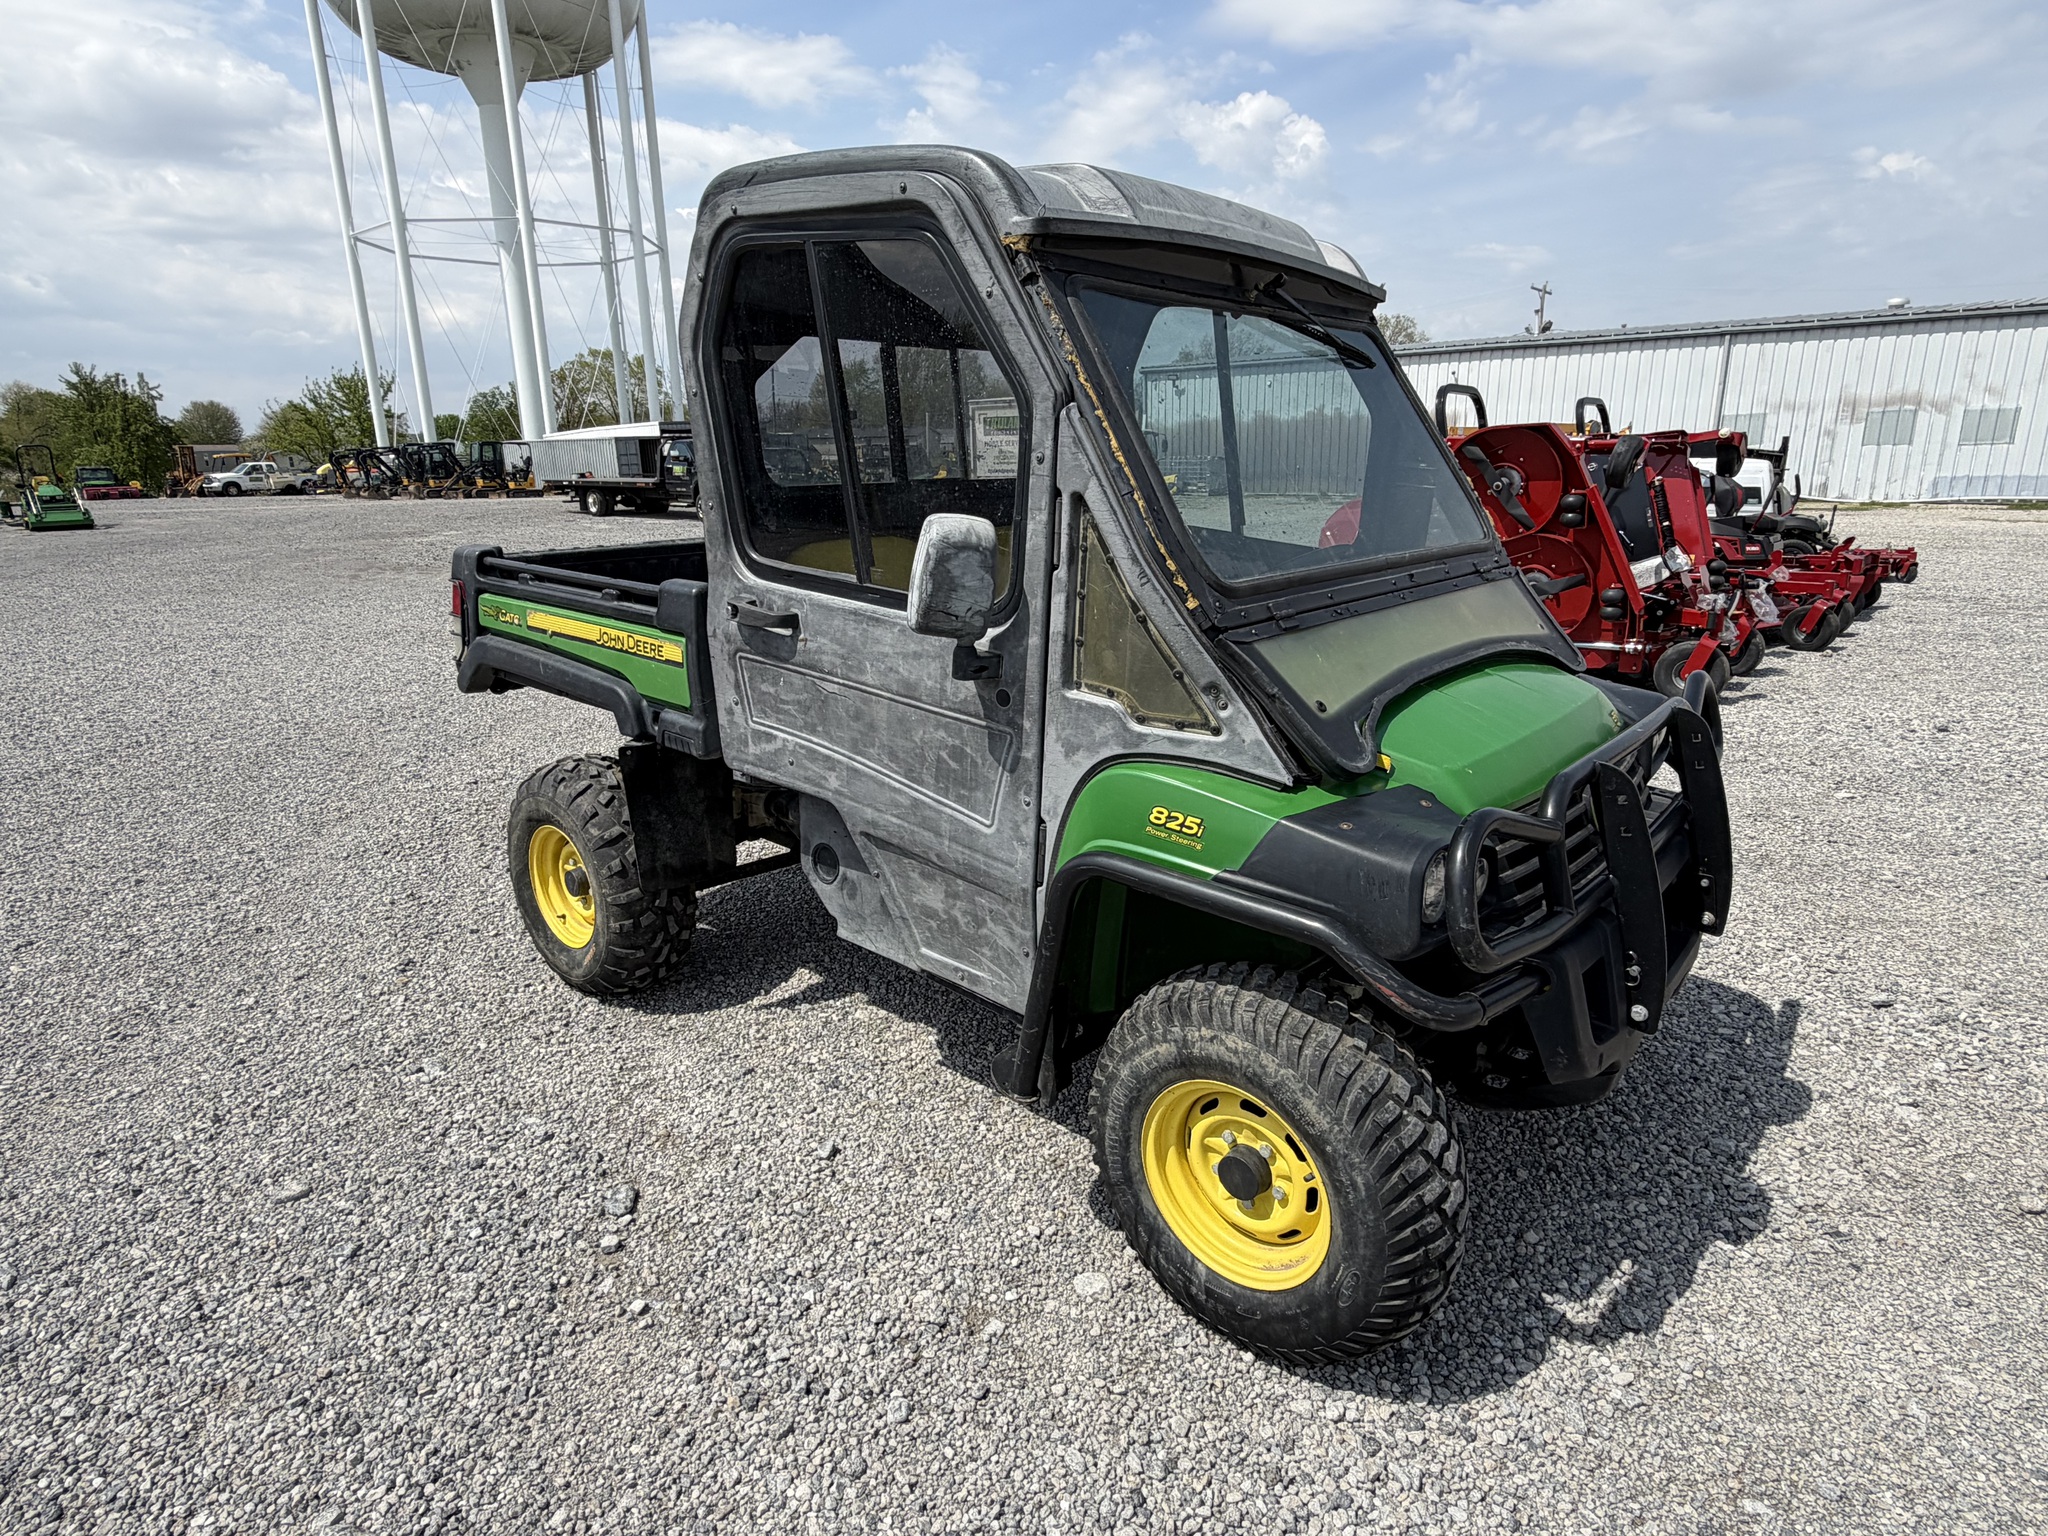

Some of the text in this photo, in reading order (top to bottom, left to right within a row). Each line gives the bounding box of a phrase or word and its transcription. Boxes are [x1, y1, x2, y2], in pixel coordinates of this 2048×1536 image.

[596, 628, 665, 658] JOHN DEERE
[1149, 805, 1205, 839] 825i
[1145, 826, 1204, 850] Power Steering
